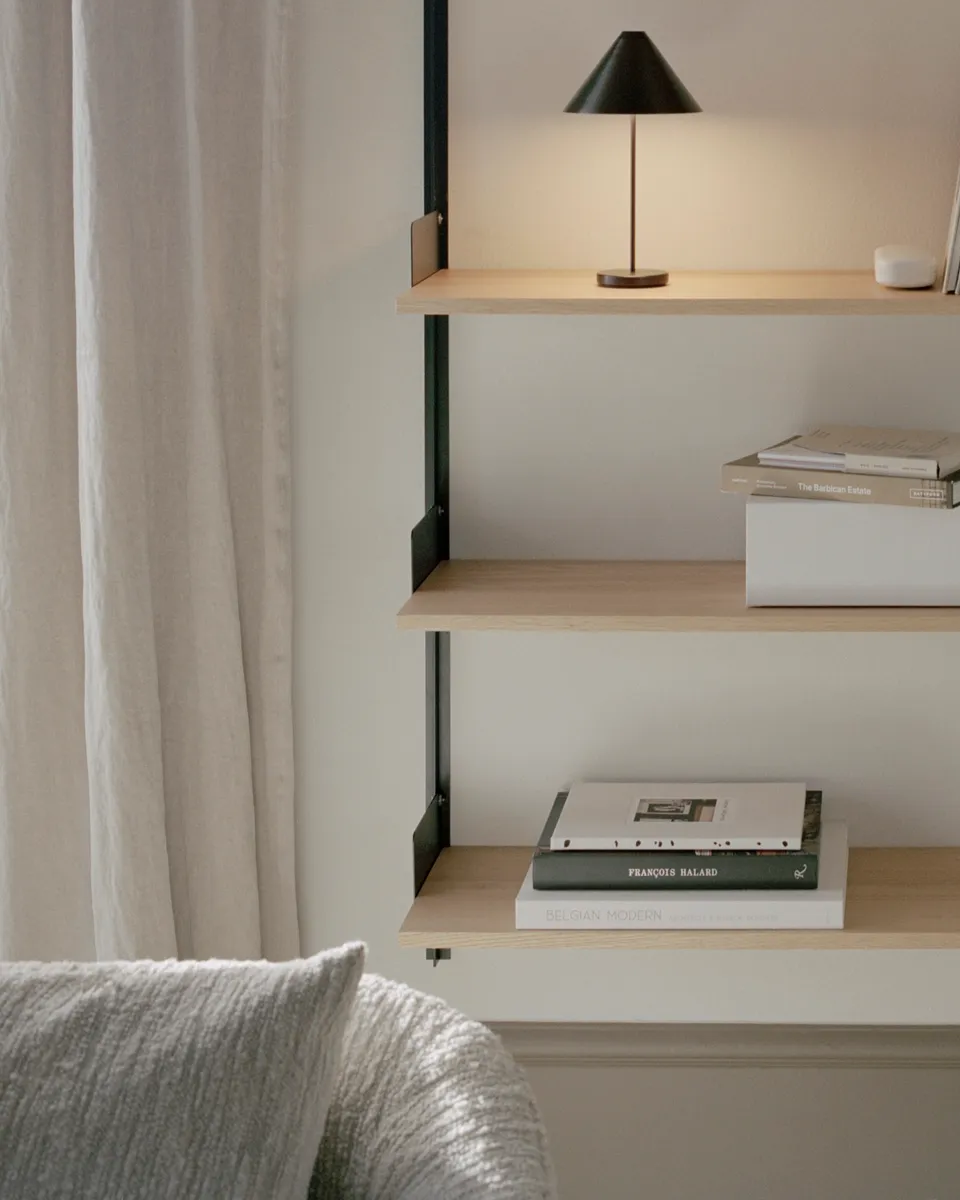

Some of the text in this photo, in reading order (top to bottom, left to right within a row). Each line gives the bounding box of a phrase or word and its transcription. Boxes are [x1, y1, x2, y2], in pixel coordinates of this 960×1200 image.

[798, 482, 812, 492] The
[813, 483, 846, 494] Barbican
[848, 485, 872, 496] Estate
[628, 867, 718, 879] FRANÇOIS HALARD
[546, 909, 600, 922] BELGIAN
[607, 909, 663, 922] MODERN
